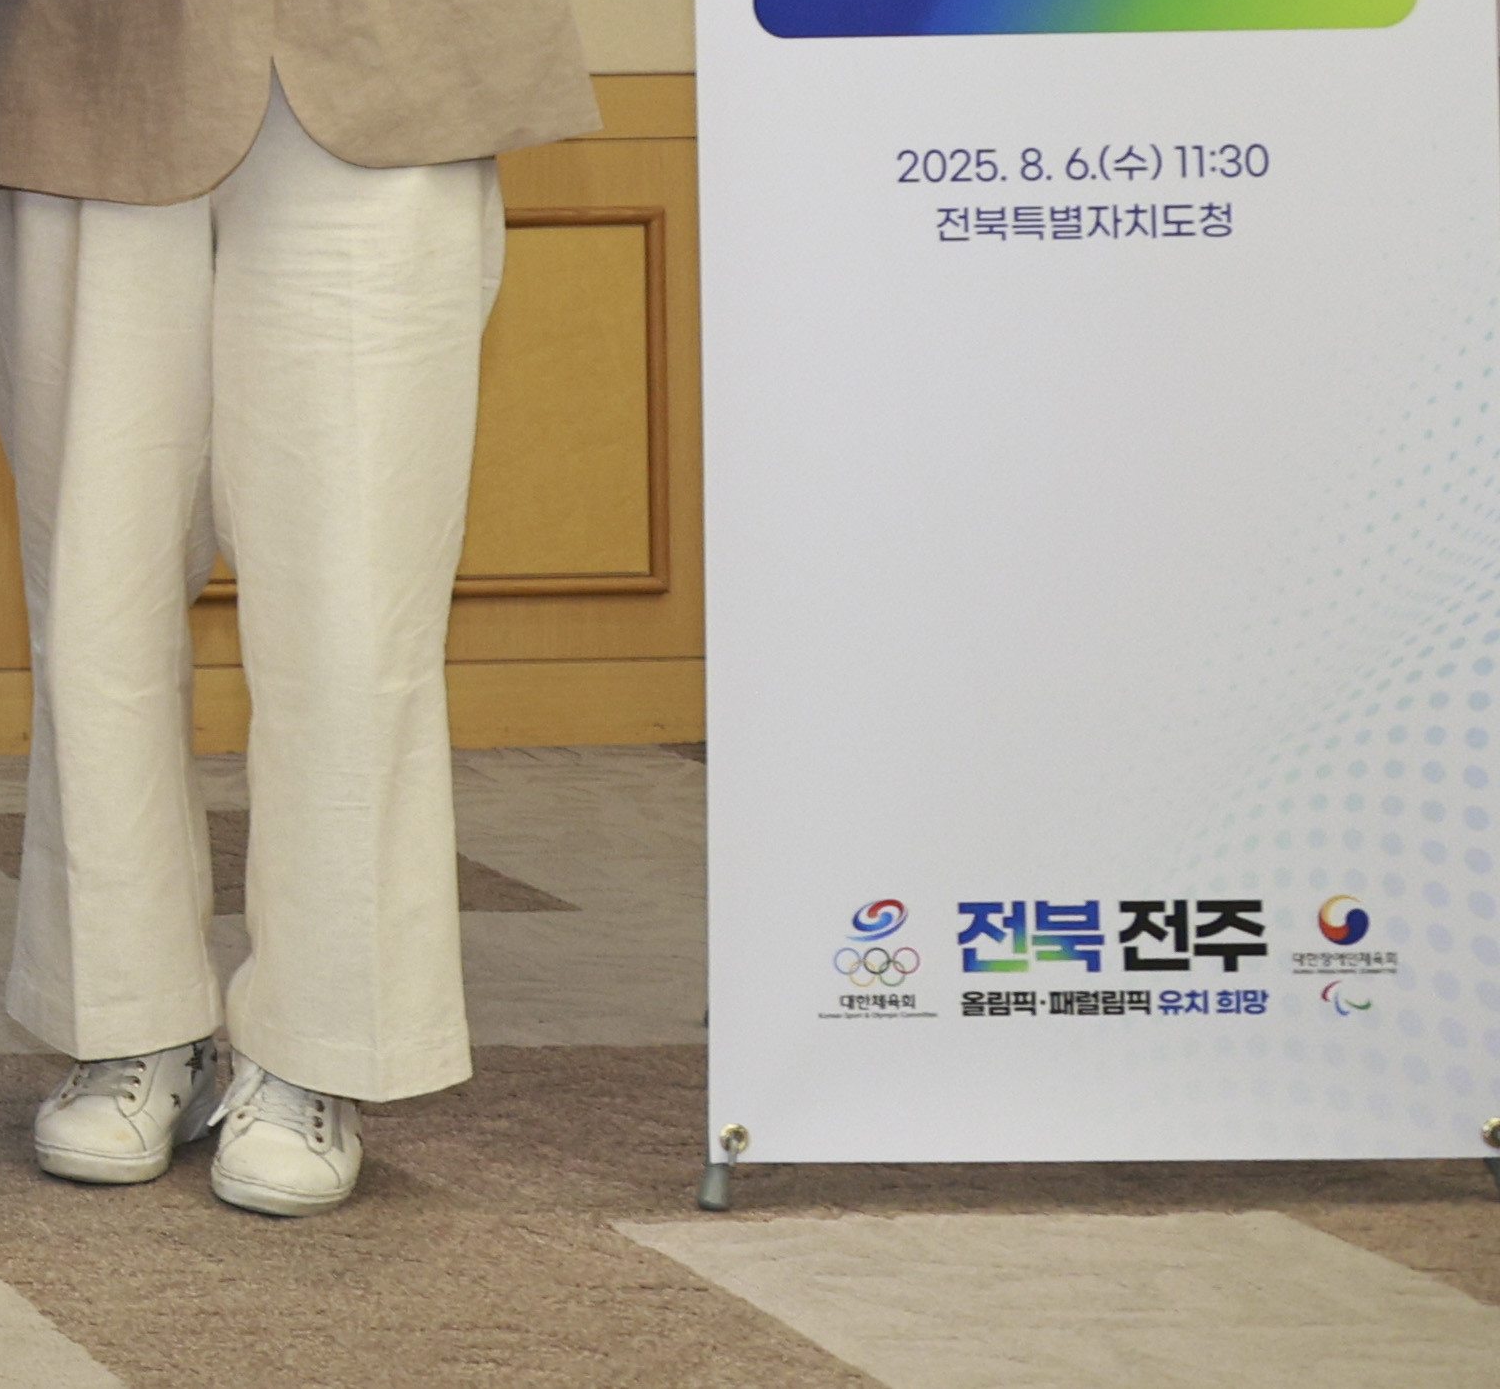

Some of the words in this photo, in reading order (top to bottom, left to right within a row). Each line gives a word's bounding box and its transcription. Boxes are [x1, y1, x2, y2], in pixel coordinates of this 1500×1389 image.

[896, 148, 1007, 183] 2025.
[1020, 147, 1053, 182] 8.
[1065, 143, 1163, 181] 6.(수)
[1174, 143, 1270, 179] 11:30
[936, 202, 1233, 242] 전북특별자치도청
[957, 899, 1105, 973] 전북
[1118, 899, 1268, 973] 전주
[839, 993, 916, 1011] 대한체육회
[1157, 989, 1209, 1016] 유치
[1216, 989, 1269, 1015] 희망
